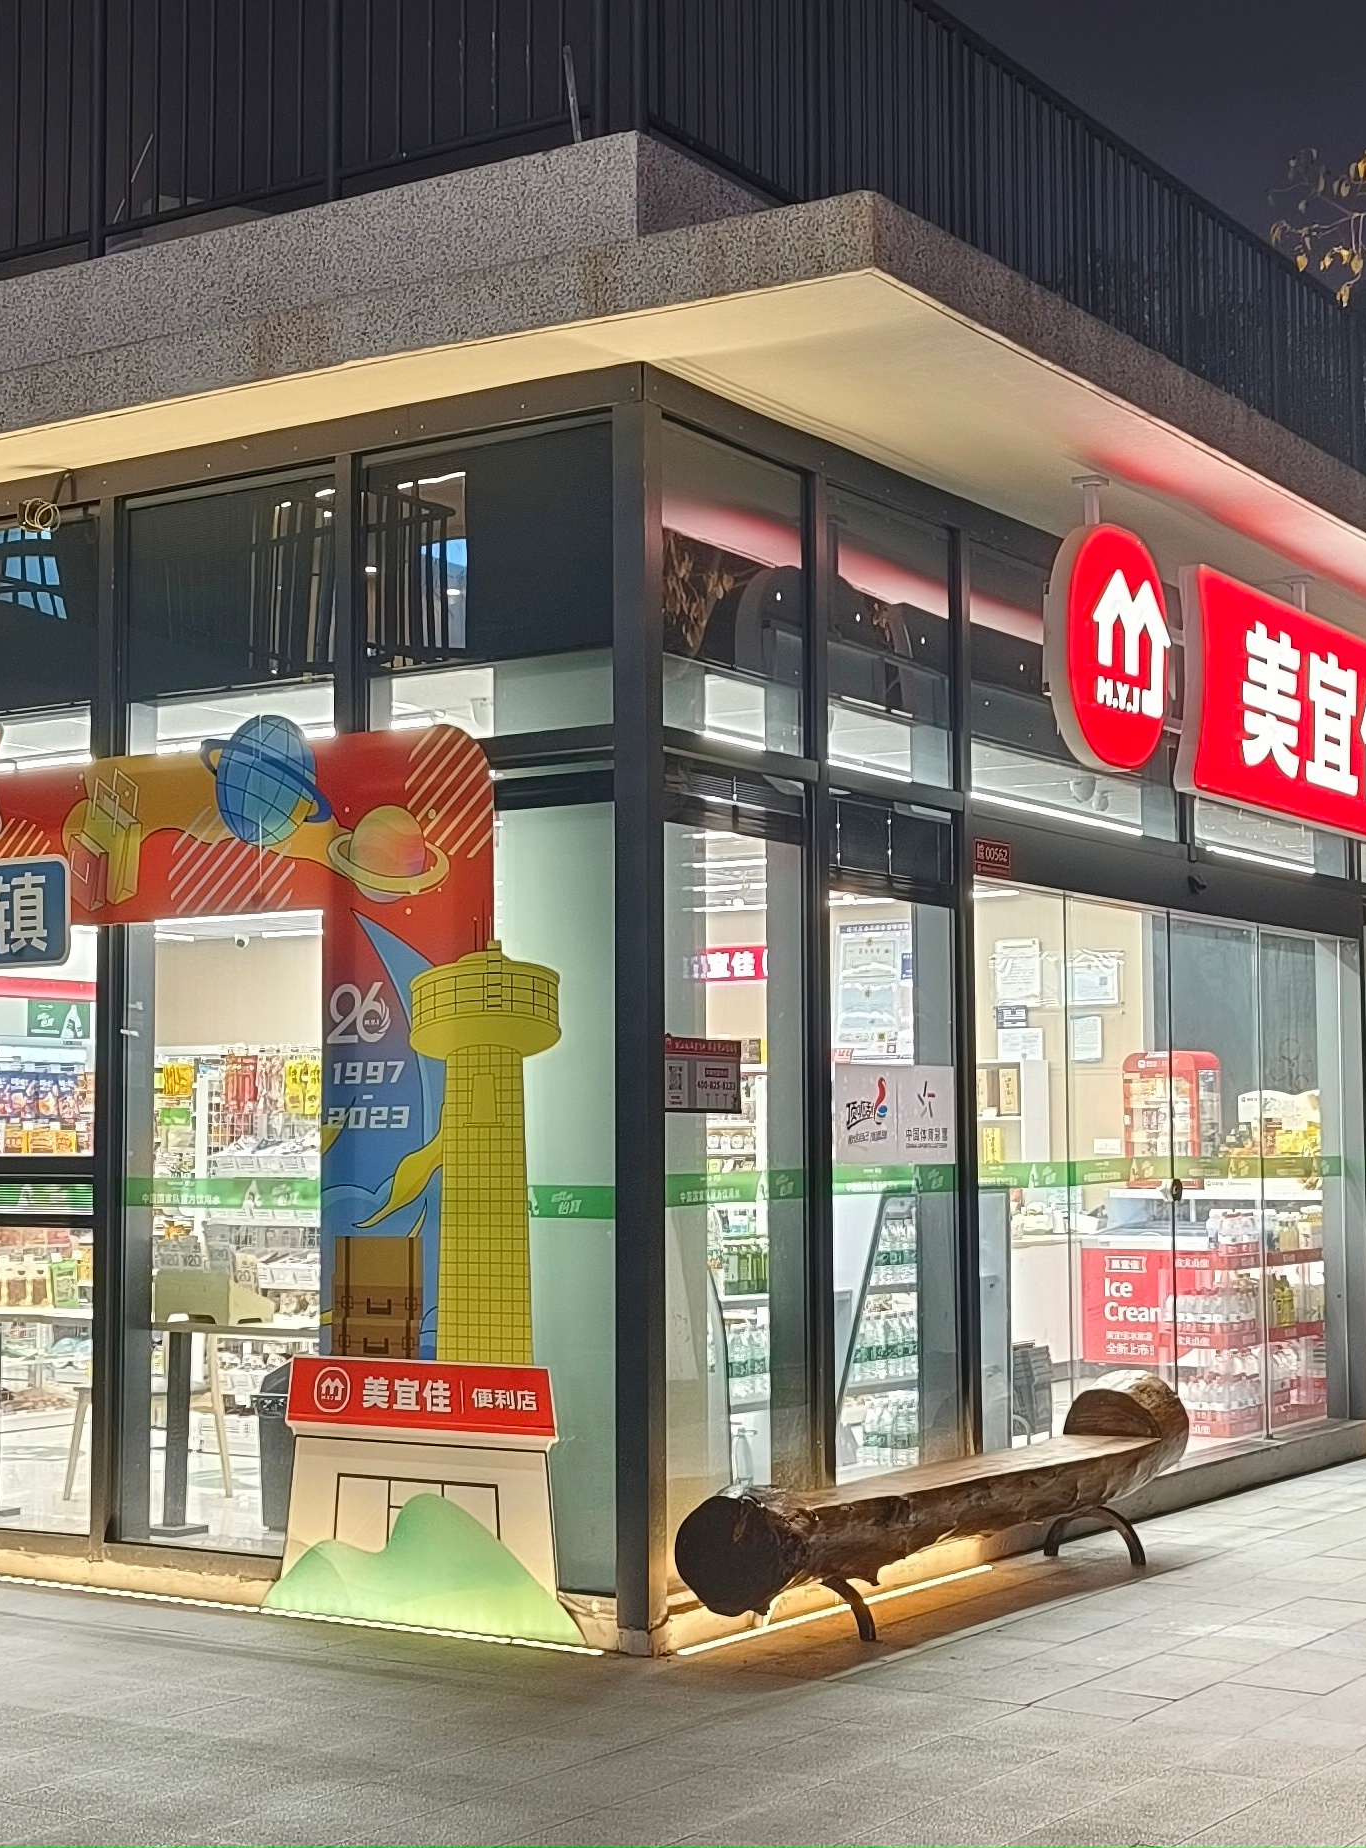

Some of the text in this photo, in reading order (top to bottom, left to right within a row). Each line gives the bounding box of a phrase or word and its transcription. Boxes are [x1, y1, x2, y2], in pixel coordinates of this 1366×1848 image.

[333, 1061, 405, 1084] 1997
[324, 1106, 410, 1129] 2023
[906, 1127, 948, 1142] 中国体育彩票
[1104, 1277, 1134, 1298] Ice
[362, 1376, 452, 1413] 美宜佳
[471, 1387, 537, 1412] 便利店
